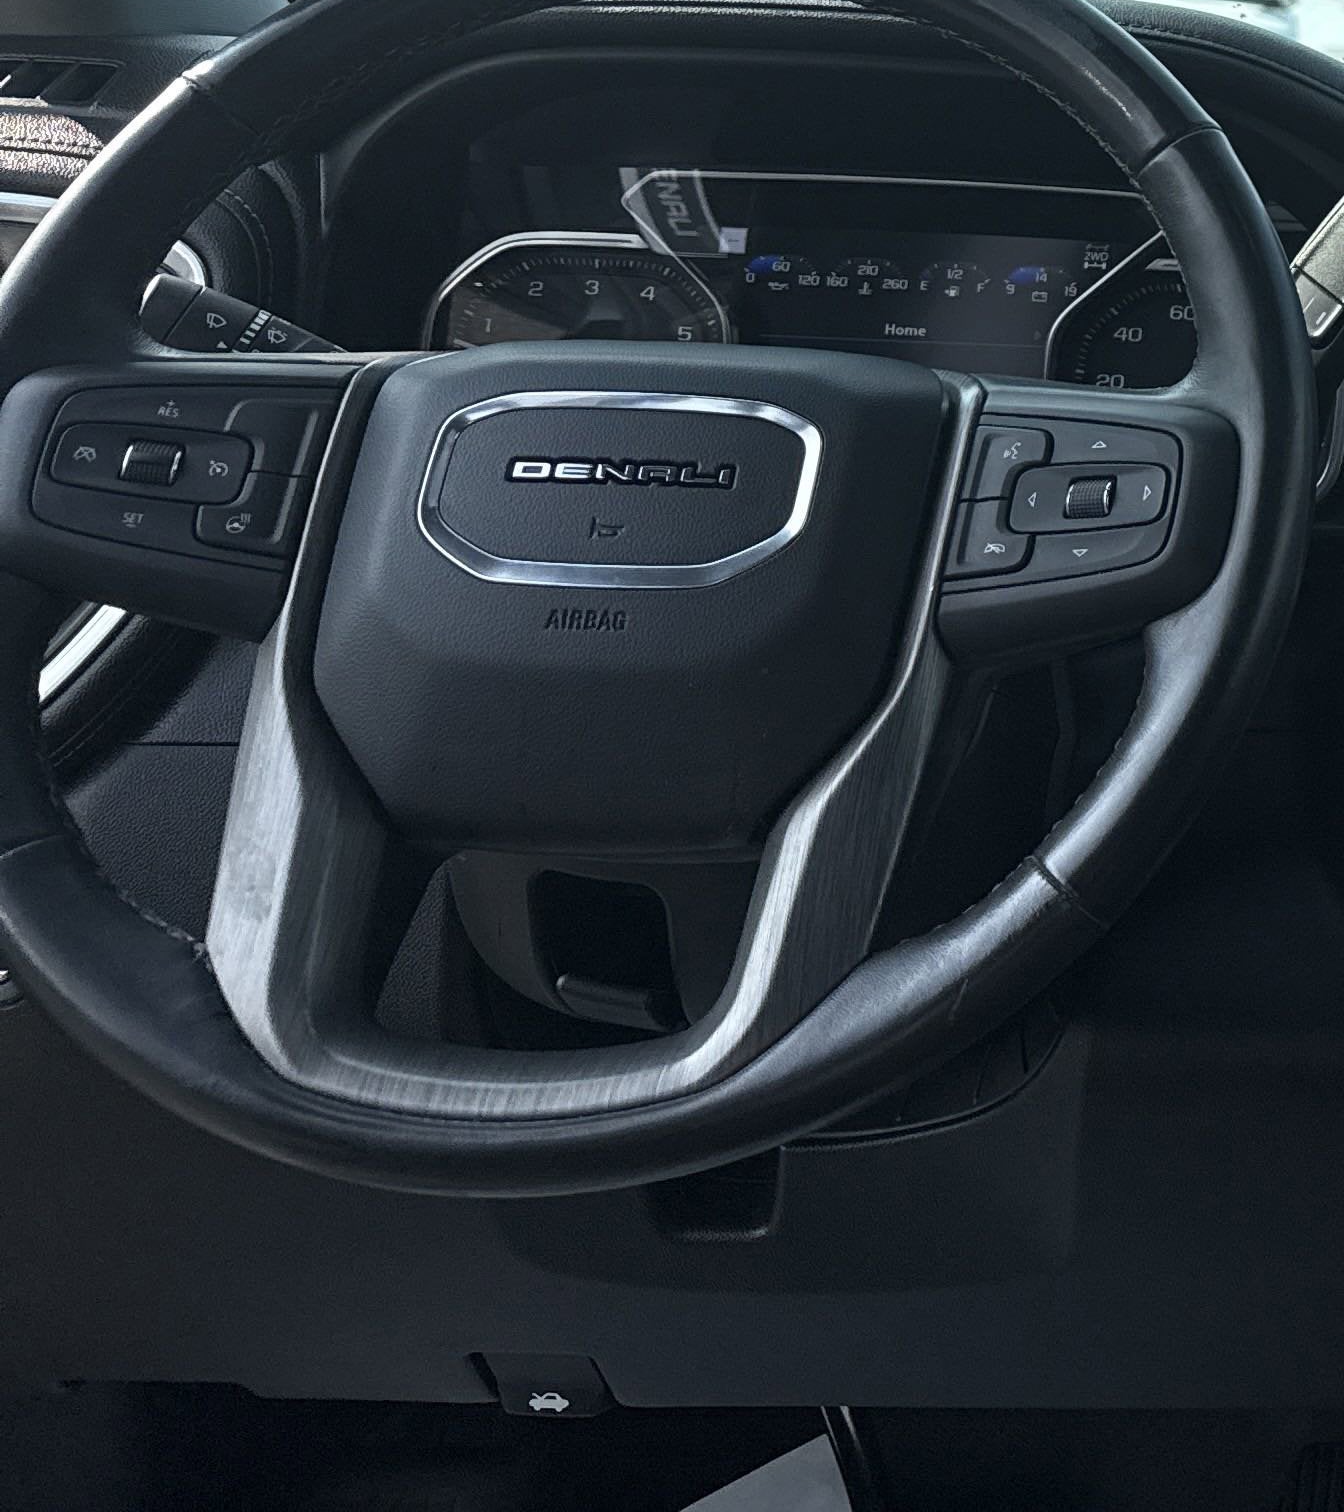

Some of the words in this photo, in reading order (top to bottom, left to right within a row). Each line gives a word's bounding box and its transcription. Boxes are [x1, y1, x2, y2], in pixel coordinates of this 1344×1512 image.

[1084, 251, 1109, 262] 2WD
[772, 260, 791, 273] 60
[857, 265, 879, 277] 210
[798, 273, 821, 287] 120
[825, 274, 849, 288] 160
[946, 268, 964, 281] 1/2
[527, 281, 544, 297] 2
[584, 280, 600, 296] 3
[882, 278, 908, 291] 260
[919, 280, 928, 292] E
[976, 282, 985, 294] F
[639, 285, 657, 301] 4
[1169, 304, 1196, 321] 60
[677, 326, 694, 341] 5
[884, 322, 927, 337] Home
[1113, 327, 1143, 343] 40
[1096, 373, 1125, 388] 20
[157, 405, 182, 418] RES
[510, 460, 736, 488] DENALI
[122, 511, 145, 524] SET
[544, 608, 628, 631] AIRBAG
